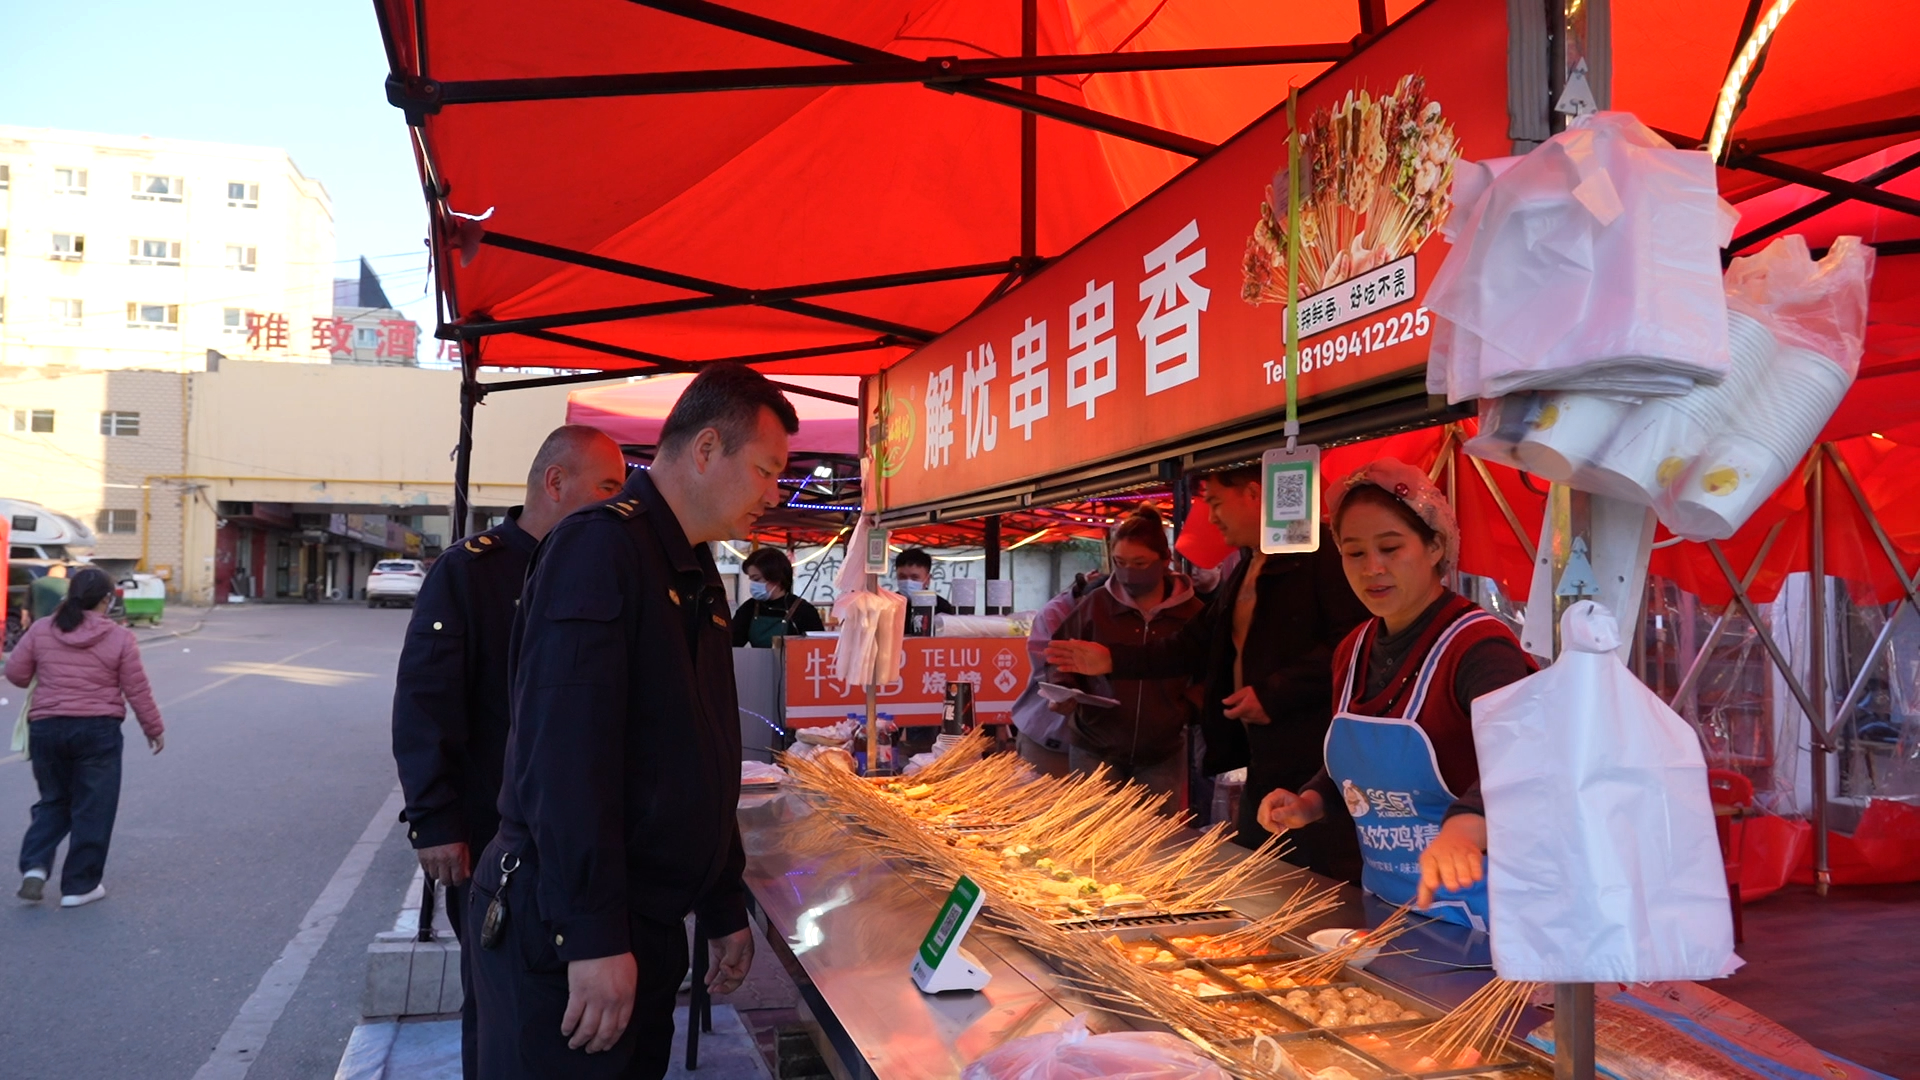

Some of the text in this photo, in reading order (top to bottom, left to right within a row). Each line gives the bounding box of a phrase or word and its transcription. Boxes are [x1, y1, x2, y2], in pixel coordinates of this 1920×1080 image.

[1297, 268, 1406, 331] 辣鲜香，好吃不贵
[924, 218, 1211, 471] 解忧串串香
[921, 649, 945, 668] TE
[950, 648, 980, 667] LIU
